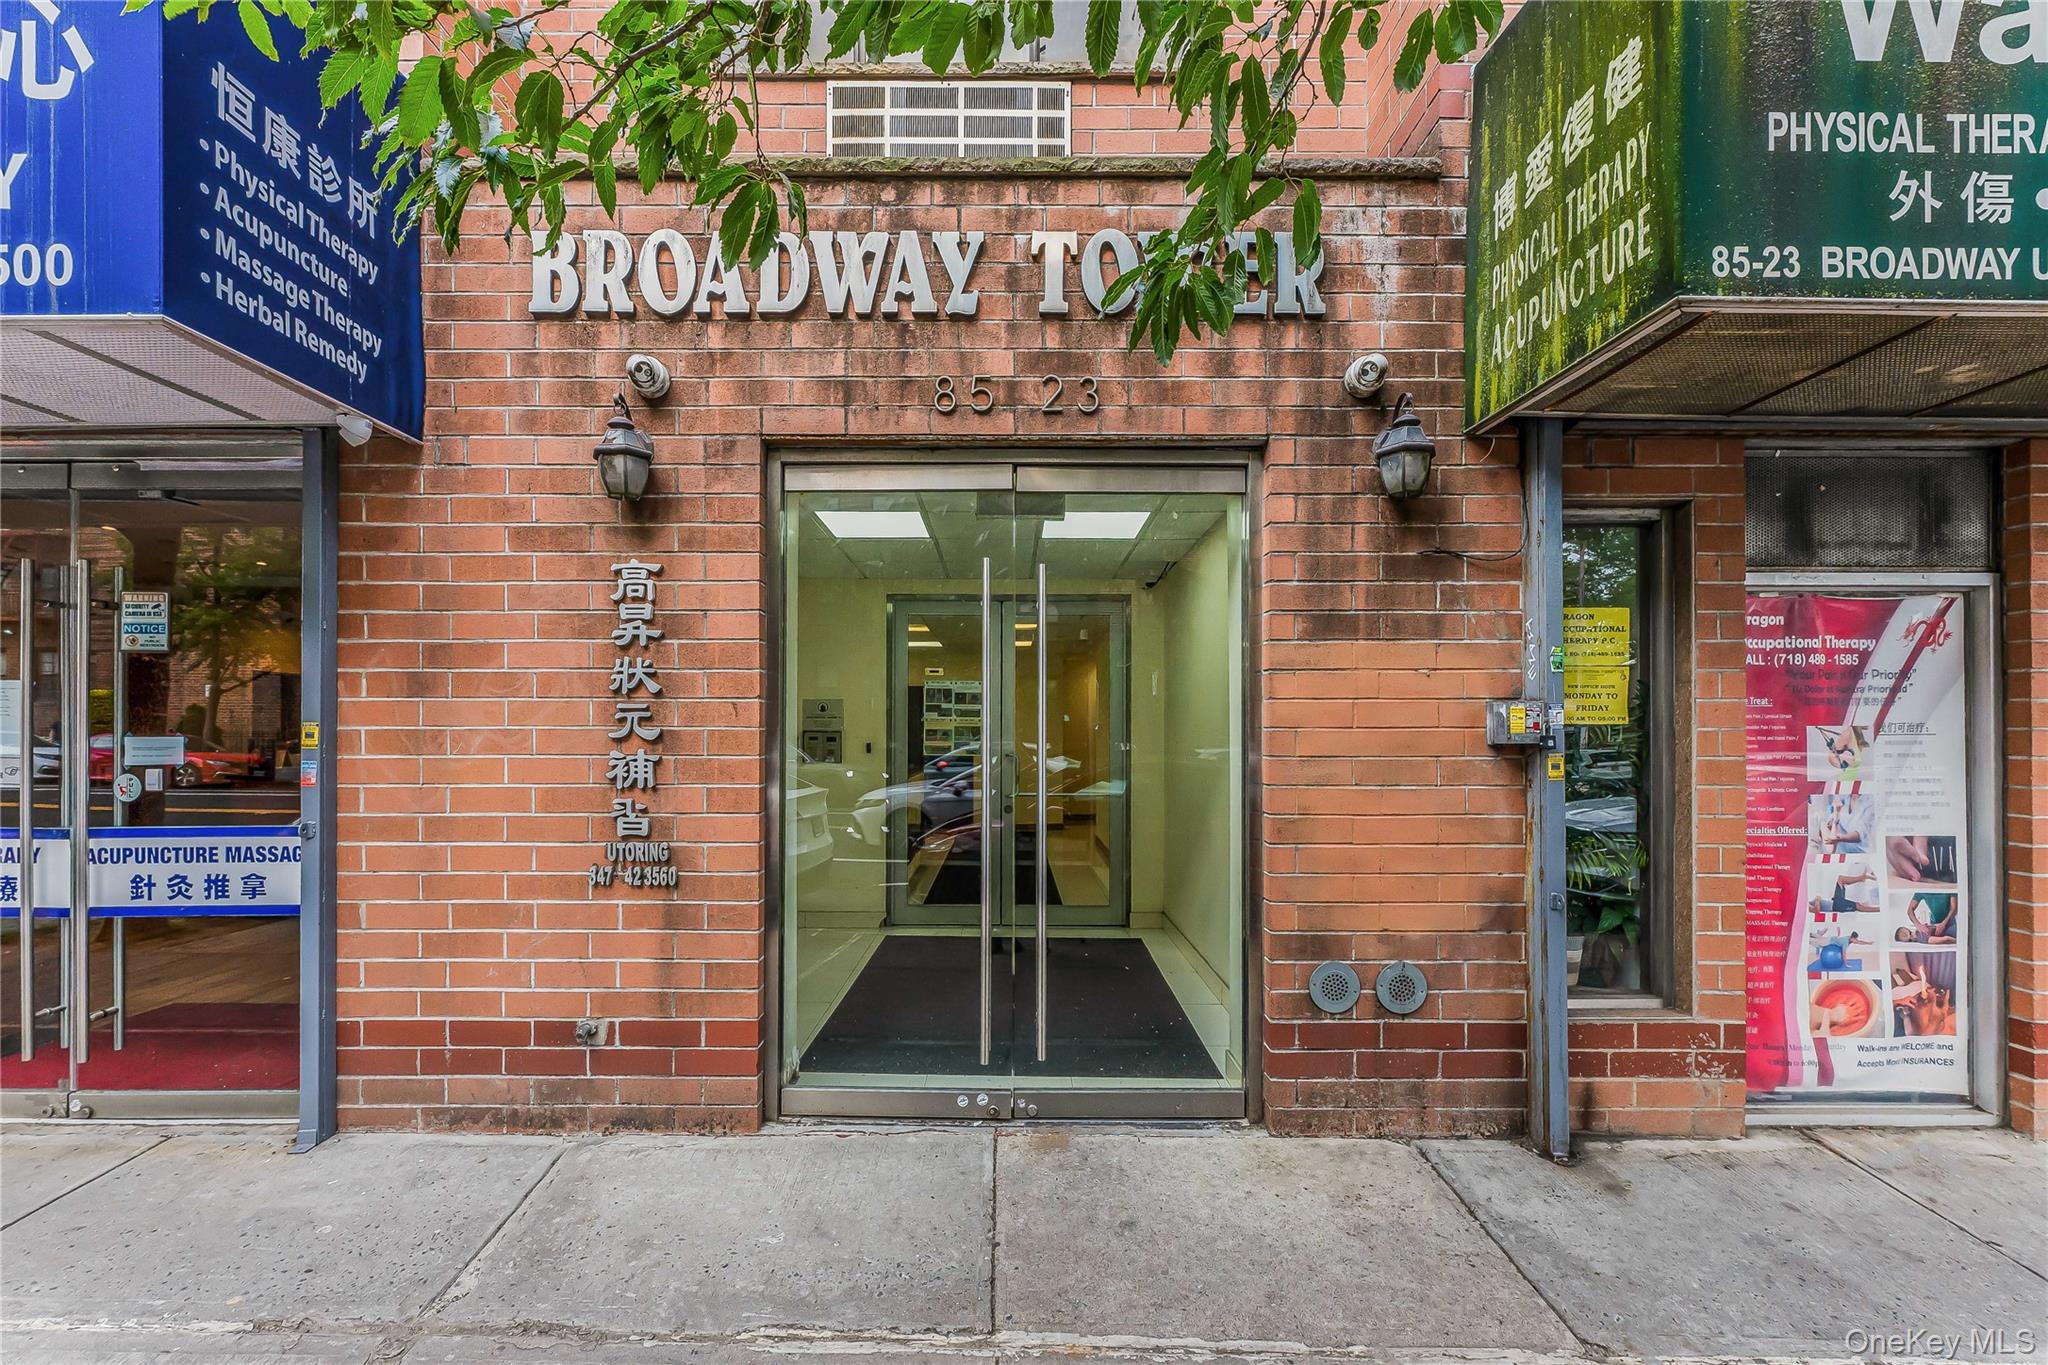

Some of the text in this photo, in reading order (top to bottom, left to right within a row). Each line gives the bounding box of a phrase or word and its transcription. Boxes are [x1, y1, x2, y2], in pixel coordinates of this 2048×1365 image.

[1767, 111, 1935, 153] PHYSICAL
[214, 140, 379, 285] Physical Therapy
[1889, 170, 2014, 224] 外傷
[1492, 122, 1652, 309] PHYSICAL THERAPY
[214, 186, 349, 298] Acupuncture
[528, 229, 1327, 316] BROADWAY TOER
[1711, 245, 1800, 279] 85-23
[1821, 245, 2021, 280] BROADWAY
[214, 228, 382, 358] Massage Therapy
[1491, 203, 1652, 369] ACUPUNCTURE
[214, 271, 368, 384] Herbal Remedy
[934, 374, 1099, 413] 85 23
[124, 594, 165, 602] WARNING
[124, 624, 165, 633] NOTICE
[1745, 615, 1784, 627] ragon
[1745, 635, 1877, 651] ccupational Therapy
[1774, 653, 1806, 667] (718)
[1808, 654, 1826, 665] 489
[1834, 654, 1859, 665] 1585
[88, 846, 219, 864] ACUPUNCTURE
[607, 842, 669, 862] UTORING
[130, 873, 267, 902] 針灸推拿
[1857, 1044, 1887, 1052] Walk-ins
[1936, 1043, 1953, 1051] and
[1857, 1059, 1885, 1067] Accepts
